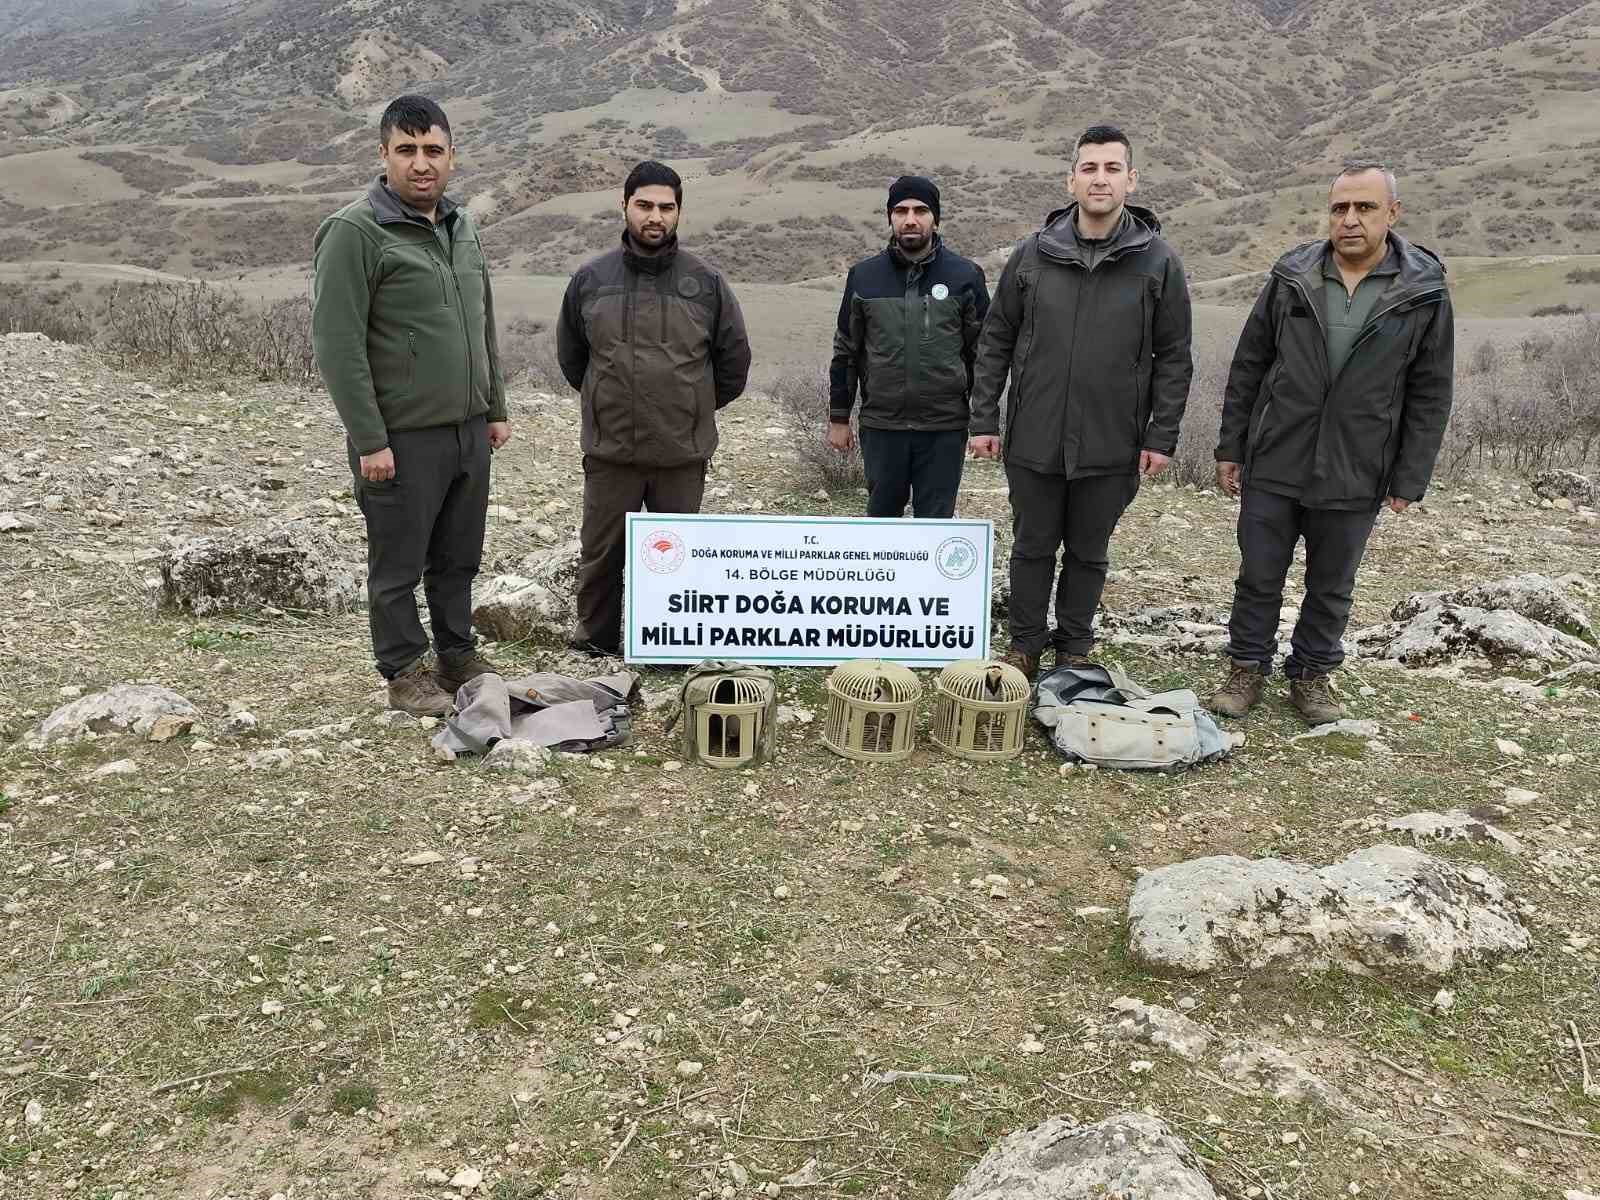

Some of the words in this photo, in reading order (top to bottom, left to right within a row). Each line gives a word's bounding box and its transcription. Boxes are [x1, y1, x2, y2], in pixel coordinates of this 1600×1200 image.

[804, 536, 819, 545] T.C.
[692, 547, 718, 559] DOĞA
[720, 549, 759, 560] KORUMA
[762, 550, 773, 560] VE
[775, 547, 798, 560] MİLLİ
[800, 550, 841, 561] PARKLAR
[843, 551, 871, 561] GENEL
[873, 549, 929, 562] MÜDÜRLÜĞÜ
[725, 569, 744, 580] 14.
[750, 567, 798, 581] BÖLGE
[803, 567, 895, 582] MÜDÜRLÜĞÜ
[668, 590, 729, 613] SİİRT
[736, 591, 804, 615] DOĞA
[811, 596, 912, 615] KORUMA
[919, 598, 949, 616] VE
[642, 622, 703, 646] MİLLİ
[711, 628, 820, 648] PARKLAR
[827, 625, 974, 649] MÜDÜRLÜĞÜ
